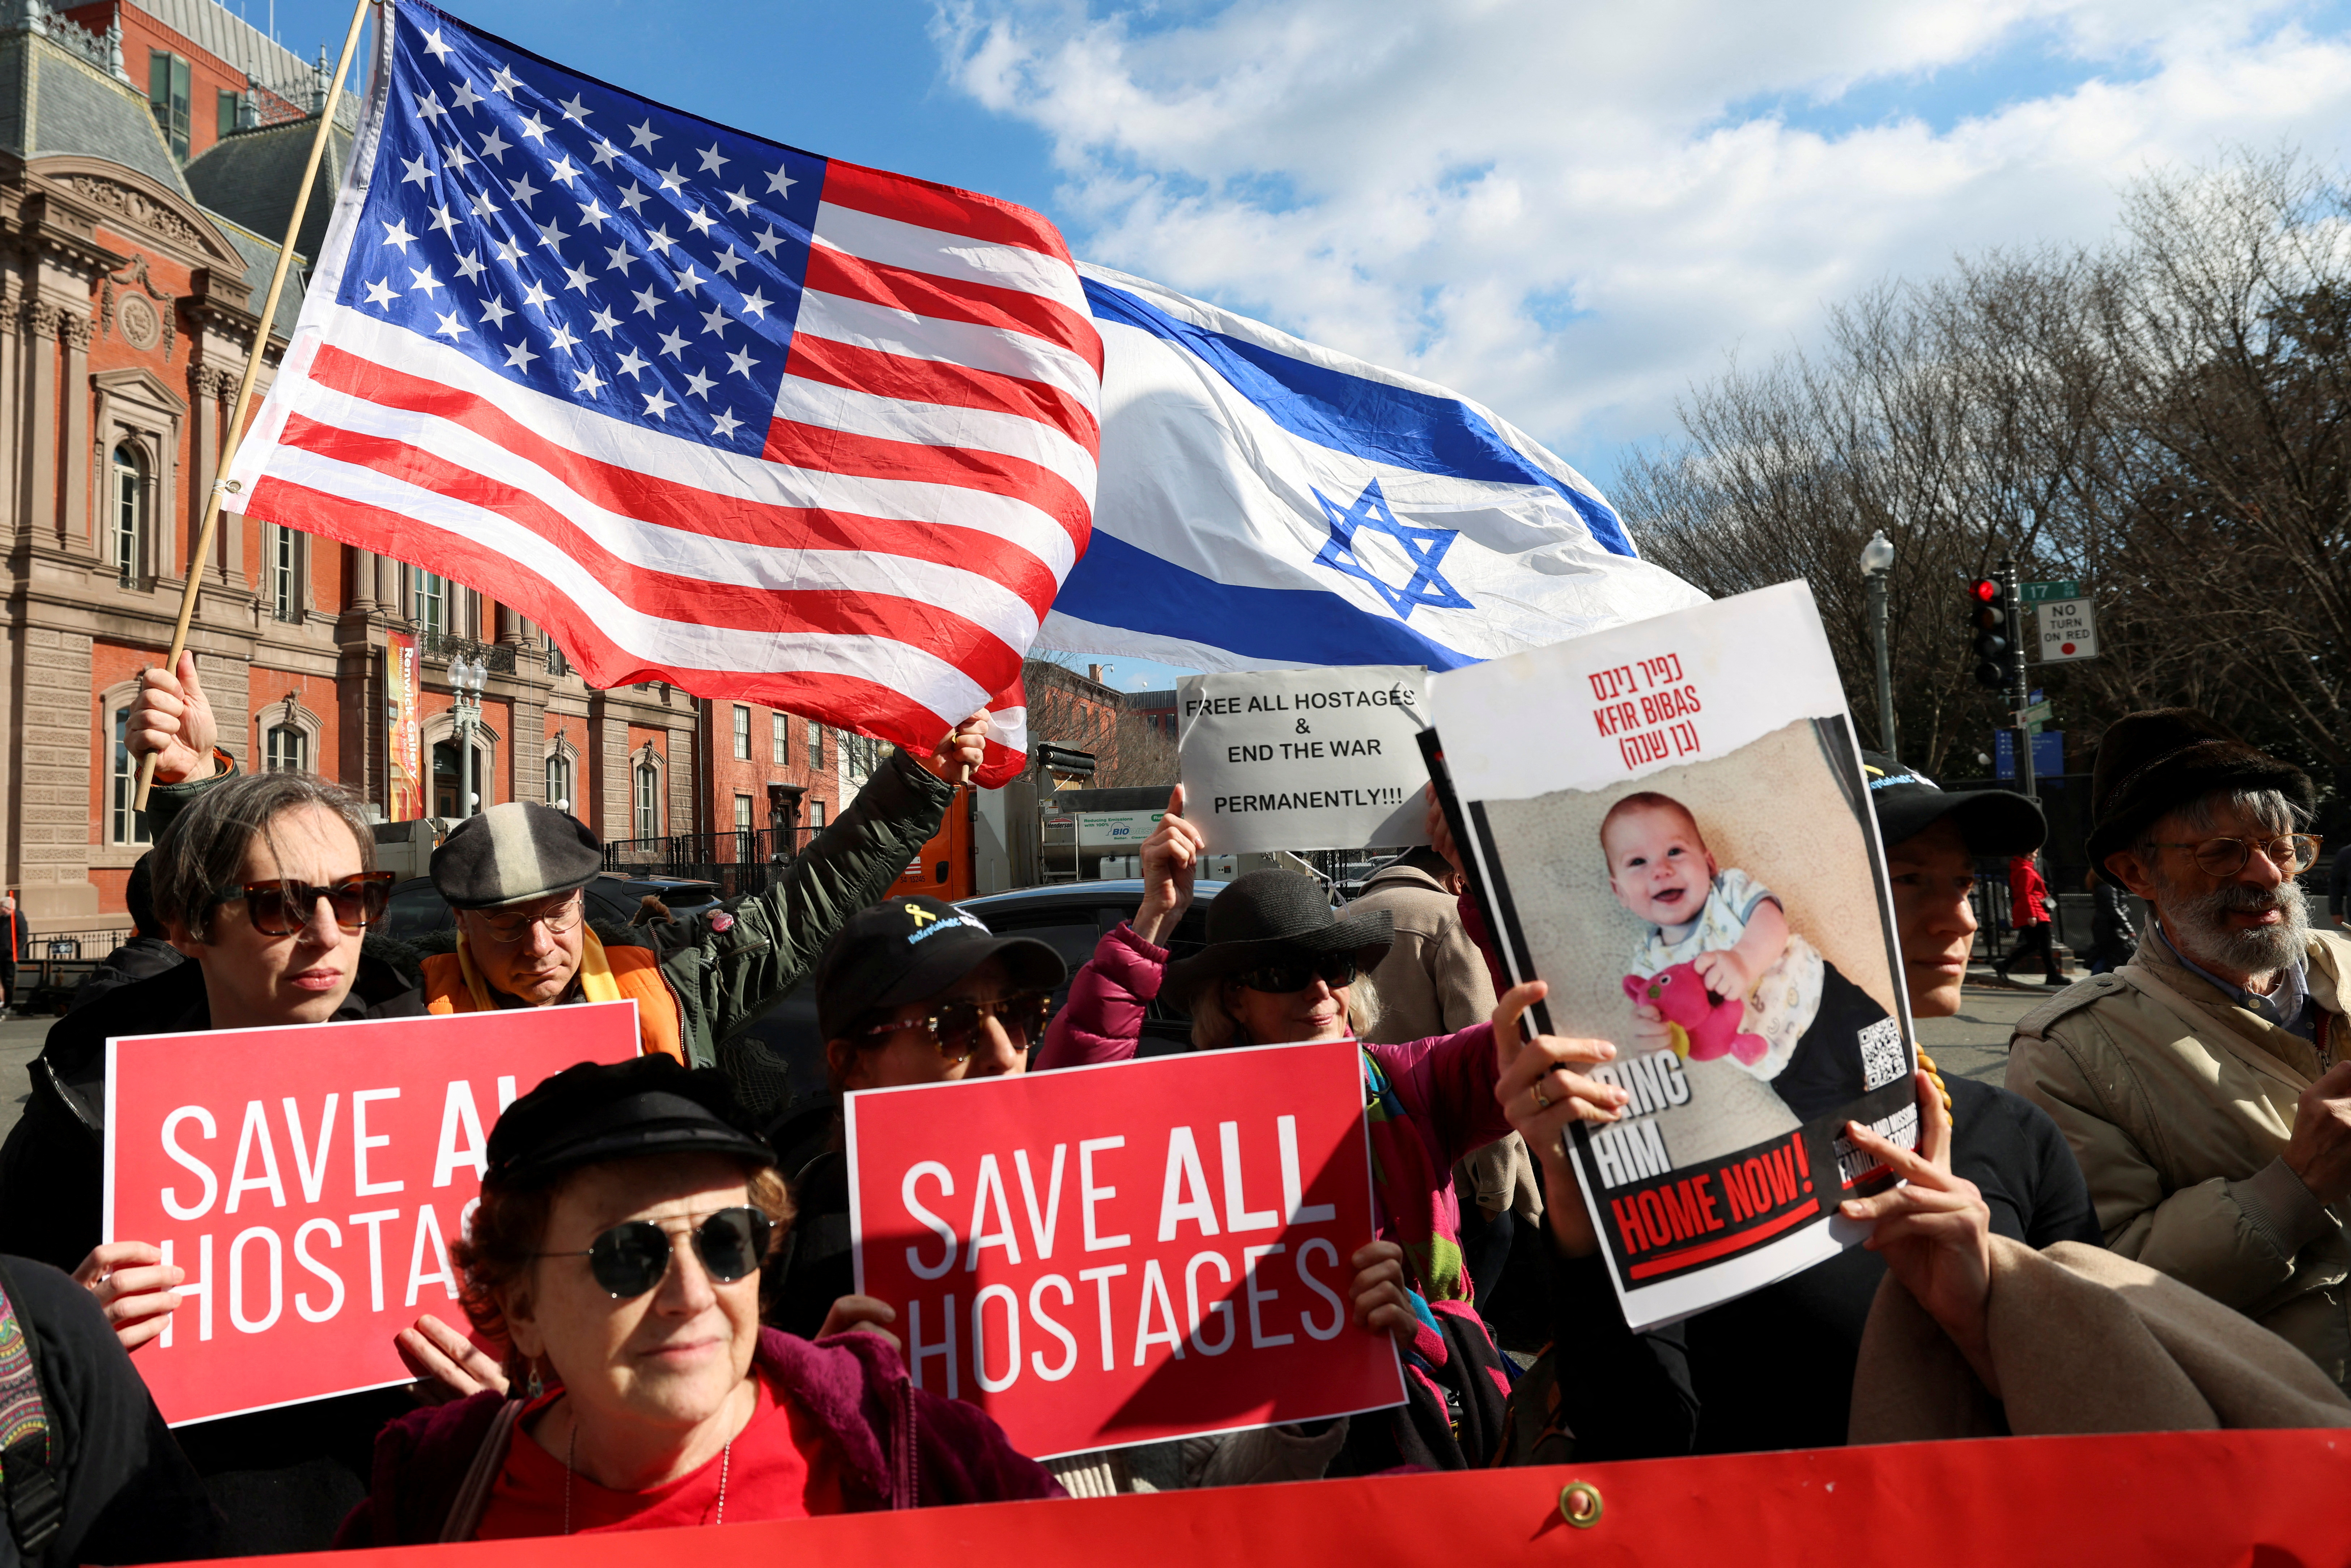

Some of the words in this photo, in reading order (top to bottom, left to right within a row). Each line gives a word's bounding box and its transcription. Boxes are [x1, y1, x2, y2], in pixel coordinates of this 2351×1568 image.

[2031, 585, 2048, 598] 17
[2052, 604, 2076, 617] NO
[2044, 633, 2061, 642] ON
[2066, 629, 2090, 640] RED
[2050, 618, 2082, 629] TURN
[404, 647, 414, 716] Renwick
[1589, 665, 1638, 701] ביבס
[1636, 653, 1683, 688] כפיר
[1186, 697, 1241, 717] FREE
[1248, 694, 1288, 713] ALL
[1295, 689, 1416, 710] HOSTAGES
[1593, 702, 1641, 737] KFIR
[1640, 685, 1701, 724] BIBAS
[1296, 718, 1310, 734] &
[1669, 720, 1700, 757] (בן
[407, 720, 416, 779] Gallery
[1229, 744, 1273, 762] END
[1280, 741, 1324, 759] THE
[1330, 739, 1382, 757] WAR
[1619, 730, 1669, 770] שנה)
[1215, 787, 1403, 813] PERMANENTLY!!!
[1587, 1049, 1690, 1119] RING
[161, 1087, 405, 1221] SAVE
[1589, 1118, 1672, 1189] HIM
[901, 1134, 1131, 1280] SAVE
[1157, 1114, 1336, 1242] ALL
[1610, 1173, 1725, 1255] HOME
[1719, 1132, 1813, 1223] NOW!
[160, 1198, 477, 1349] HOSTA
[908, 1237, 1345, 1400] HOSTAGES
